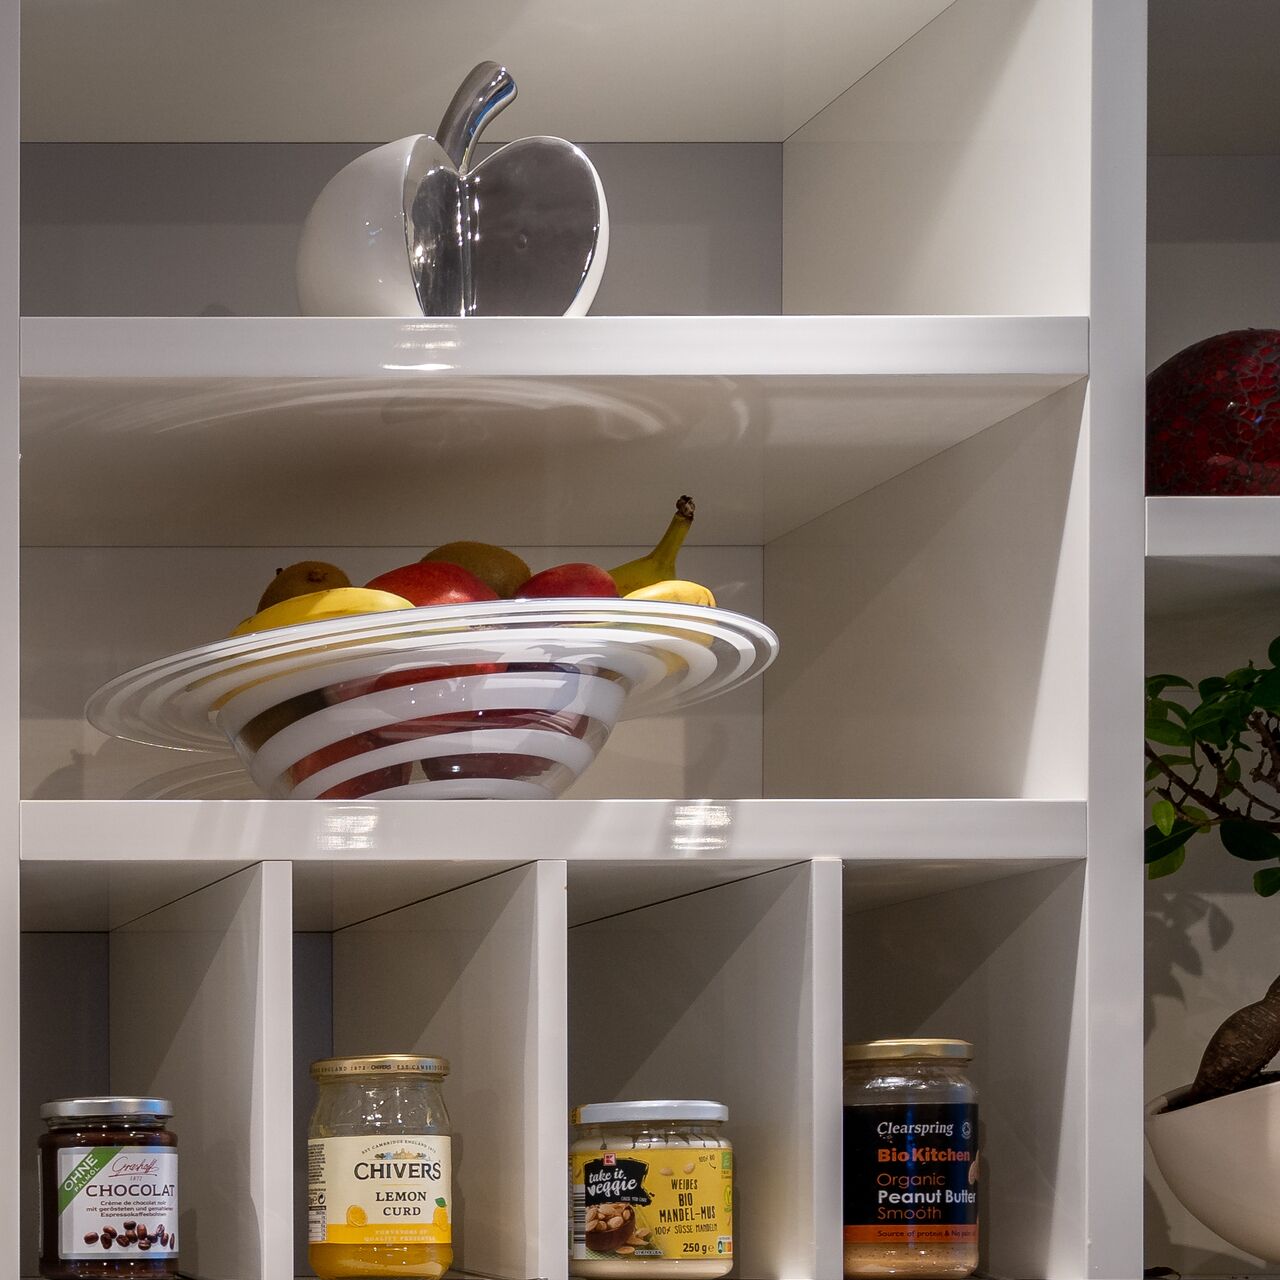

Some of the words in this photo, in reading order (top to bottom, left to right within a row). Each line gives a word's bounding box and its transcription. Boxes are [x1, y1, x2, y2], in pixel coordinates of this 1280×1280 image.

[877, 1121, 954, 1137] Clearspring
[372, 1140, 403, 1149] CAMBRIDGE
[64, 1154, 99, 1191] OHNE
[354, 1162, 441, 1181] CHIVERS
[588, 1169, 612, 1184] take
[876, 1172, 946, 1189] Organic
[86, 1184, 175, 1197] CHOCOLAT
[587, 1179, 638, 1198] veggie
[375, 1191, 428, 1202] LEMON
[678, 1192, 693, 1207] BIO
[878, 1190, 942, 1204] Peanut
[945, 1190, 976, 1204] Butter
[383, 1206, 422, 1217] CURD
[659, 1205, 716, 1223] MANDEL-MUS
[877, 1206, 942, 1220] Smooth
[917, 1230, 943, 1238] protein
[682, 1242, 700, 1253] 250
[701, 1244, 707, 1254] g
